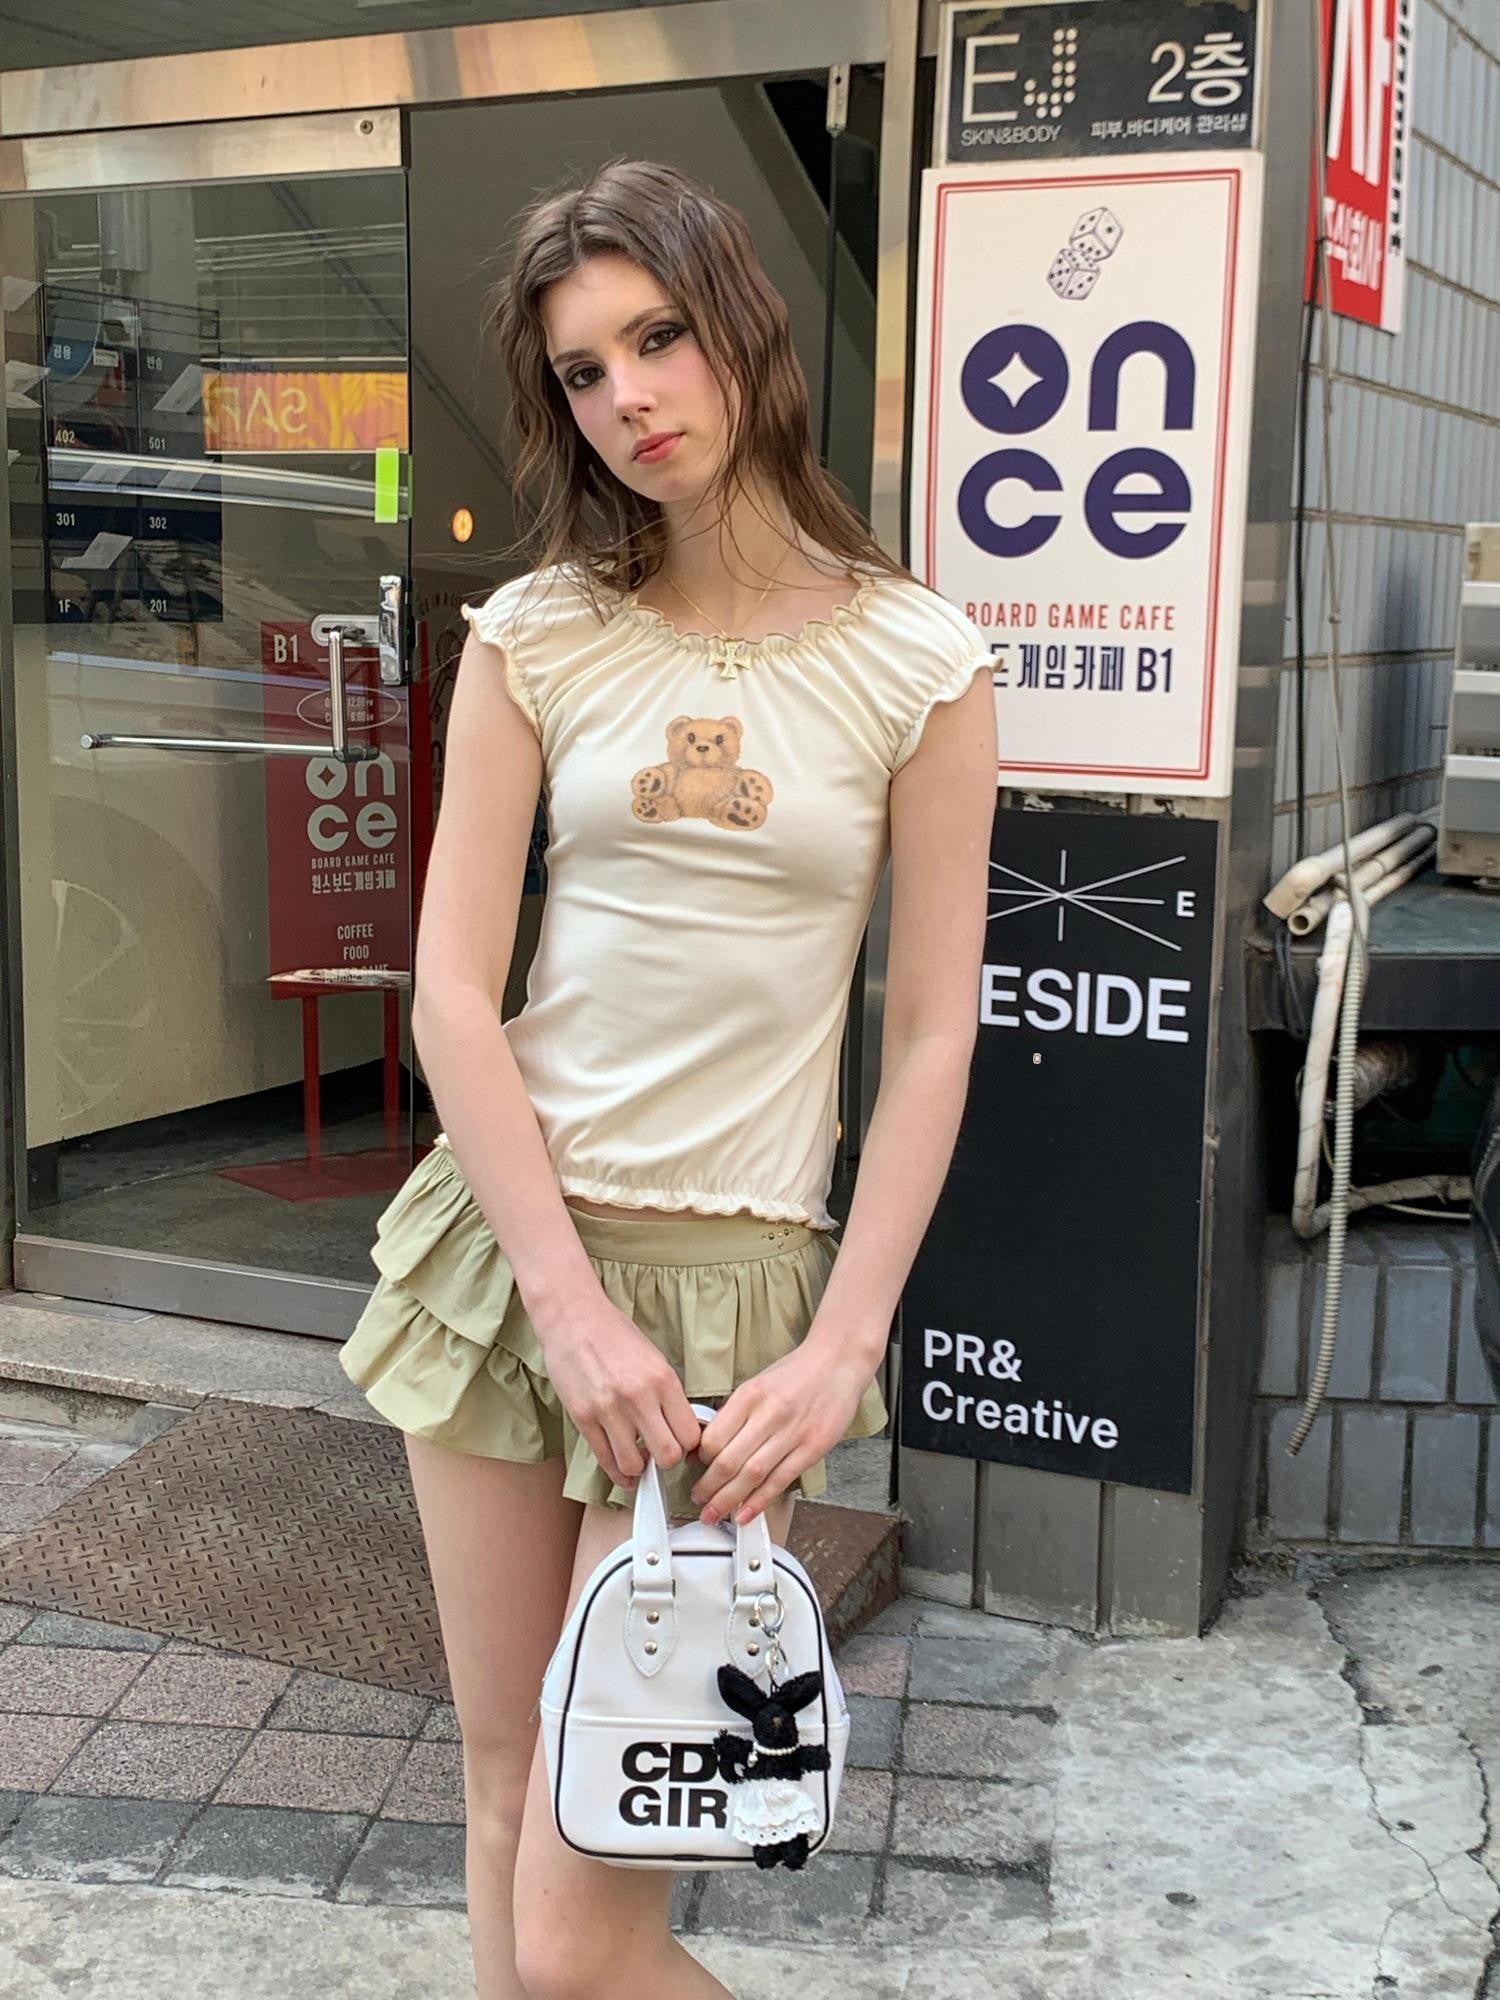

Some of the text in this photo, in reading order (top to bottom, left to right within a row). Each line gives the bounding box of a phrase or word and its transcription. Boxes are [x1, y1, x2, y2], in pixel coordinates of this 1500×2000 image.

[962, 27, 1079, 124] EJ
[1147, 31, 1249, 108] 2층
[960, 124, 1062, 147] SKIN&BODY
[55, 429, 76, 444] 402
[148, 436, 166, 451] 501
[56, 513, 76, 527] 301
[149, 516, 167, 530] 302
[58, 600, 71, 614] 1F
[149, 600, 168, 614] 201
[965, 602, 1175, 630] BOARD GAME CAFE
[274, 634, 299, 664] B1
[1136, 647, 1173, 693] B1
[311, 853, 395, 869] BOARD GAME CAFE
[1176, 891, 1195, 918] E
[337, 923, 374, 940] COFFEE
[343, 945, 369, 960] FOOD
[980, 963, 1191, 1044] ESIDE
[922, 1329, 1022, 1383] PR&
[922, 1380, 1120, 1450] Creative
